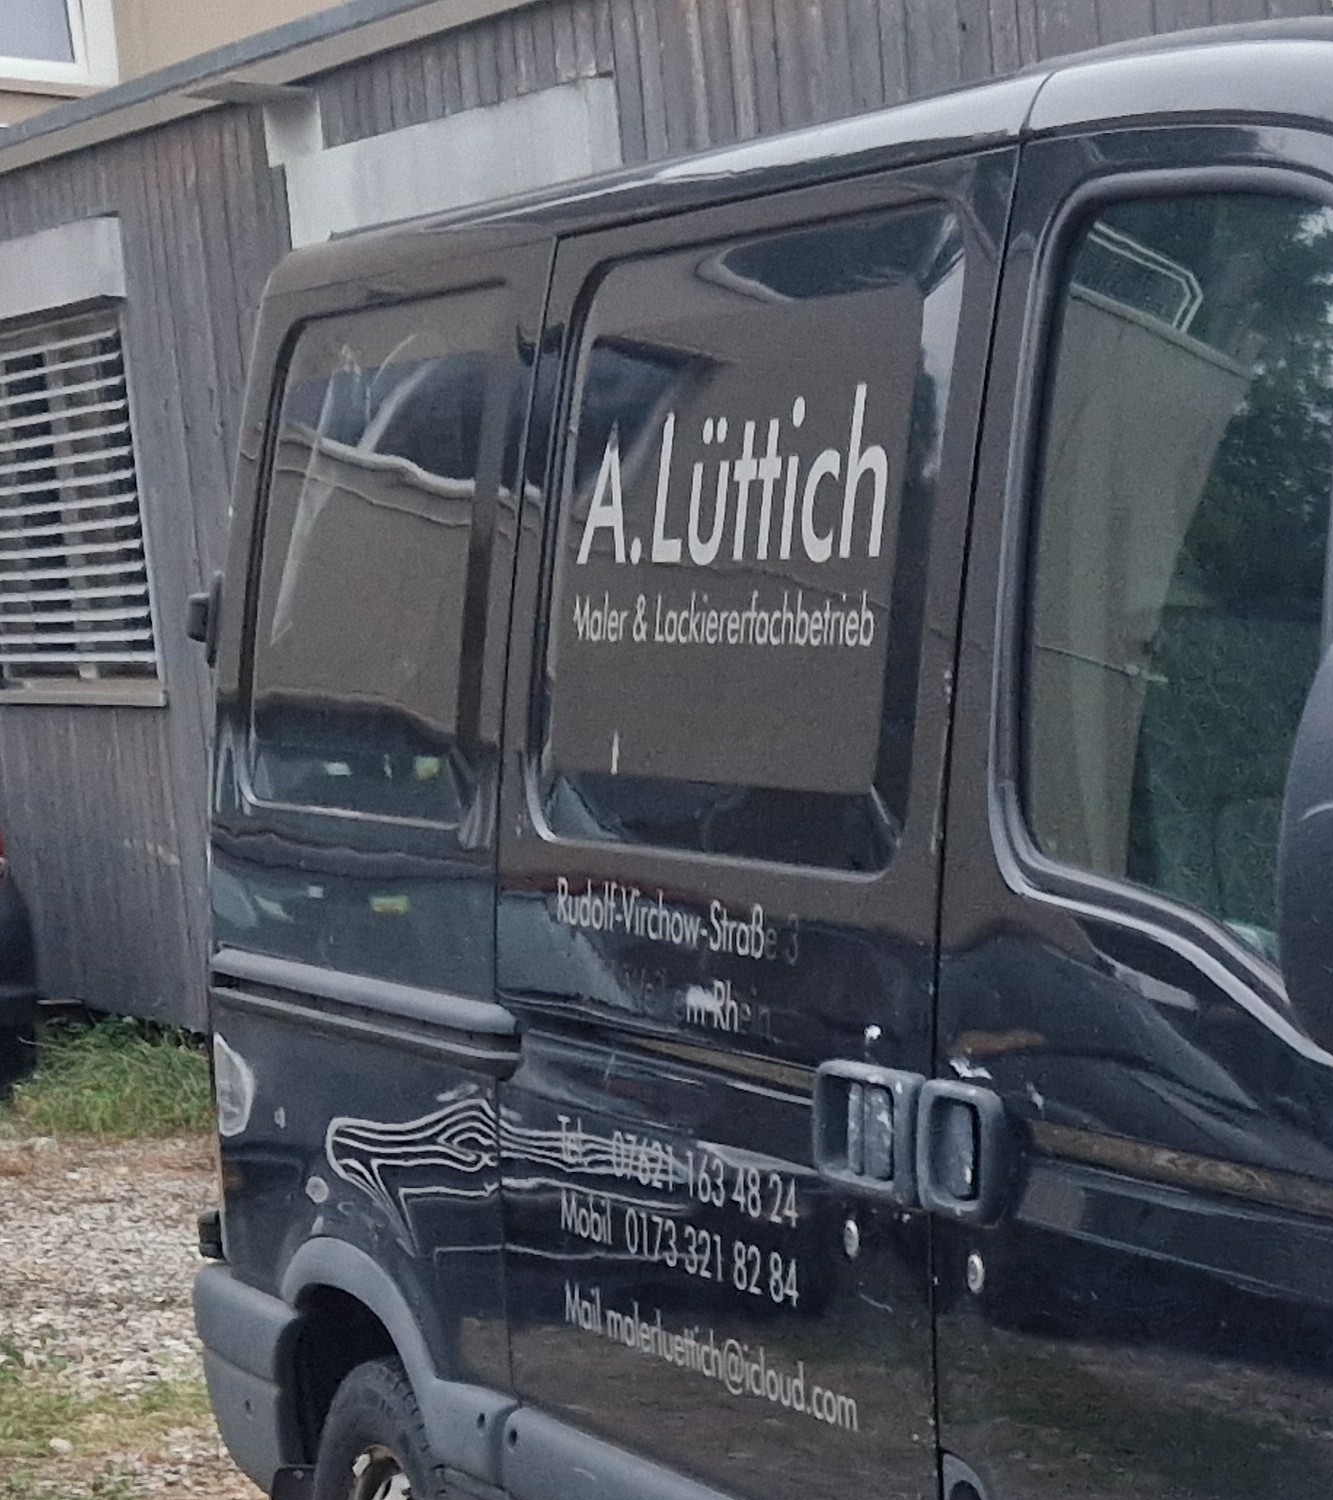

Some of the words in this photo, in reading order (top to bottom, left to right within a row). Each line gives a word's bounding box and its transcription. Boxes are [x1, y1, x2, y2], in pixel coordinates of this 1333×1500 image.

[632, 593, 648, 642] &
[654, 589, 875, 647] Lackiererfachbetrieb
[685, 1149, 725, 1207] 163
[732, 1166, 761, 1219] 48
[768, 1174, 798, 1227] 24
[560, 1189, 613, 1245] Mobil
[625, 1206, 677, 1268] 0173
[684, 1225, 723, 1282] 321
[733, 1240, 763, 1295] 82
[769, 1252, 799, 1307] 84
[565, 1279, 602, 1336] Mail
[606, 1301, 859, 1432] malerluettich@icloud.com
